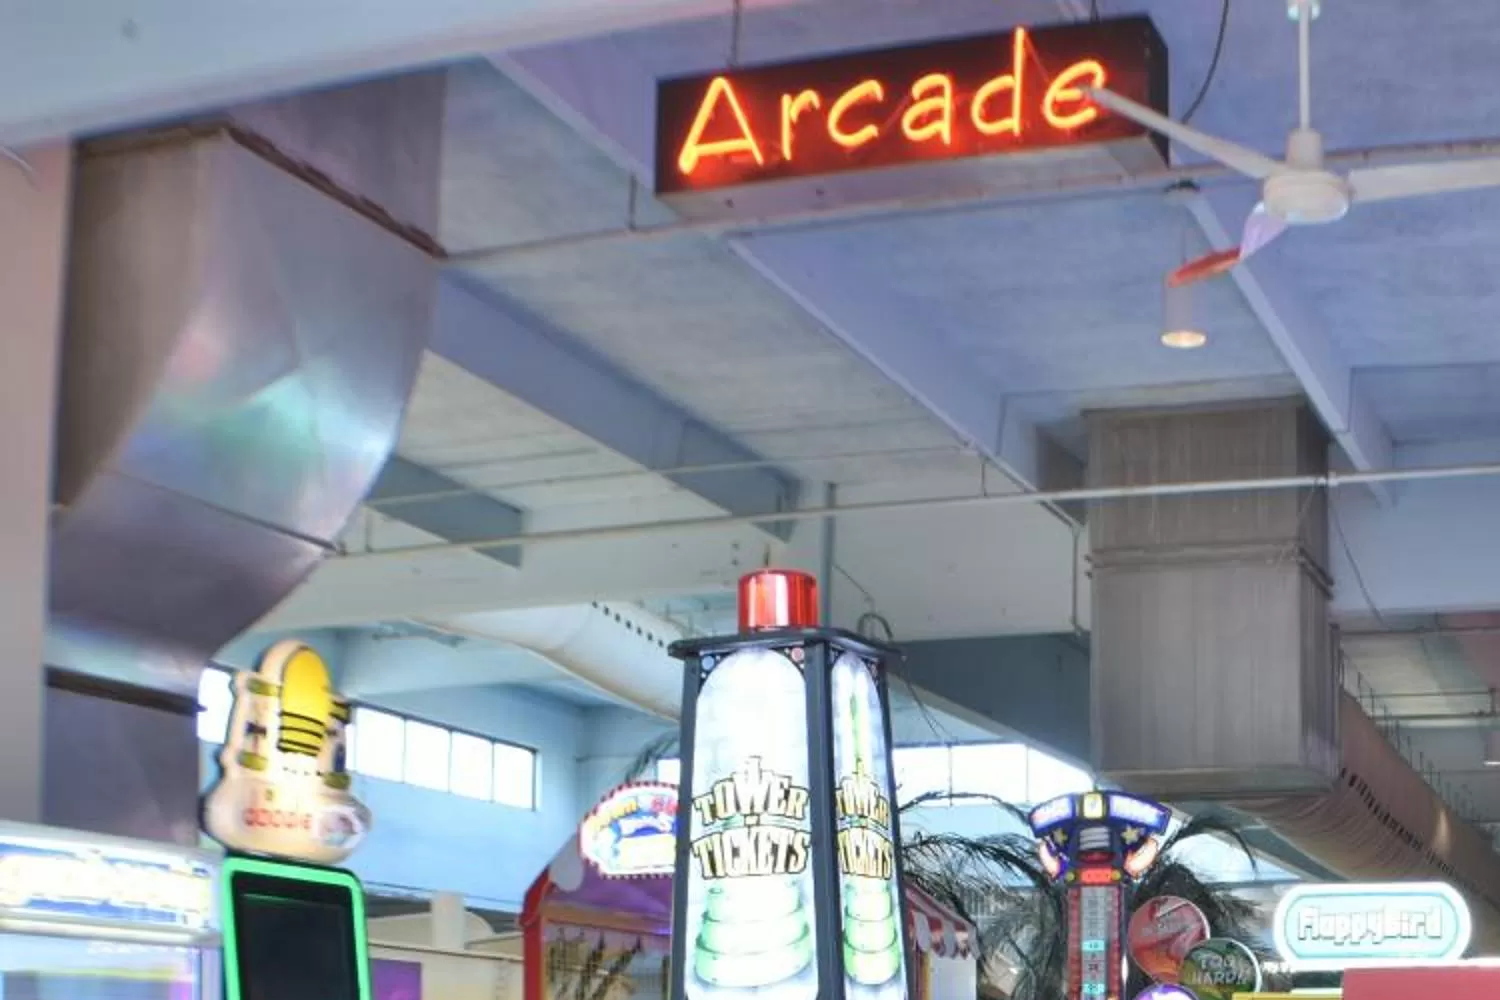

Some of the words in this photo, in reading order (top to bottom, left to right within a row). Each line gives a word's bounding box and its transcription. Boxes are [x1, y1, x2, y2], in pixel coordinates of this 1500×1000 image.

[677, 25, 1107, 174] Arcade
[692, 755, 809, 826] TOWER
[690, 825, 811, 880] TICKETS
